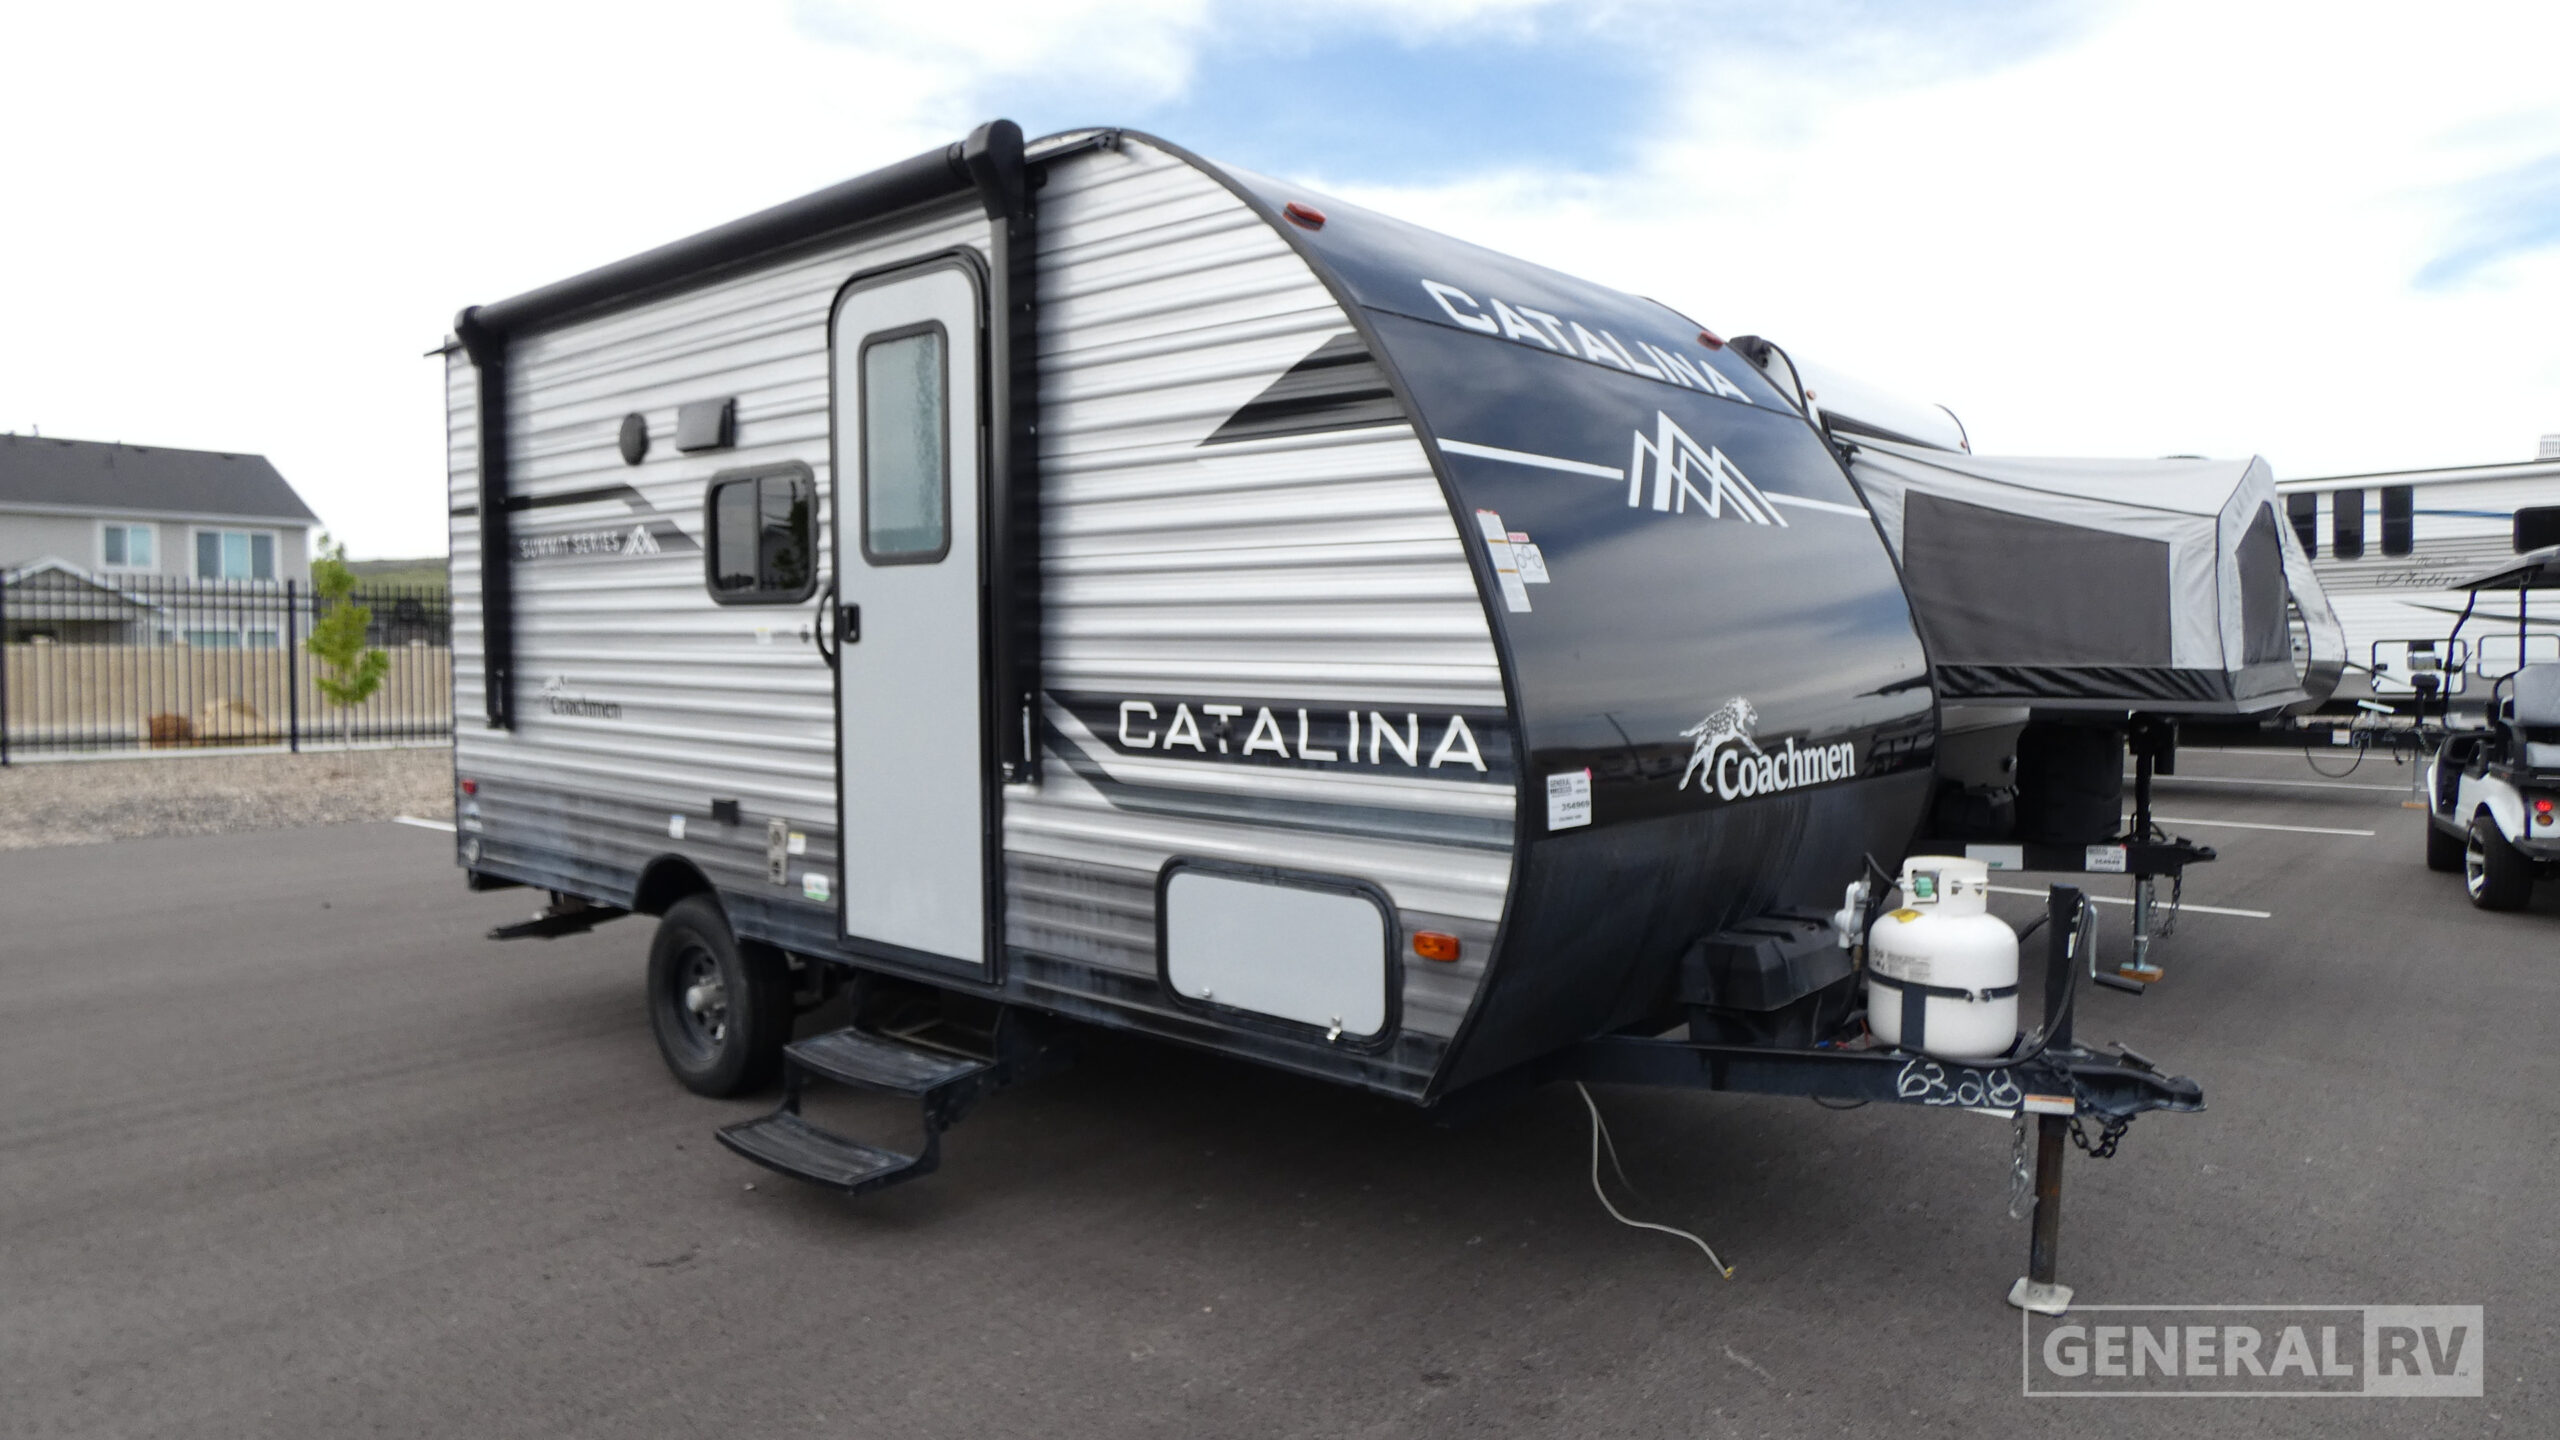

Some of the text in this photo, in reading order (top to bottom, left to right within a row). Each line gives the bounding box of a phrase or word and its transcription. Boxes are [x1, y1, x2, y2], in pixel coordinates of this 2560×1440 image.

[1421, 279, 1753, 404] CATALINA
[519, 530, 621, 558] SUMMIT SERIES
[551, 695, 622, 719] Coachmen
[1118, 700, 1488, 772] CATALINA
[1717, 736, 1856, 801] Coachmen
